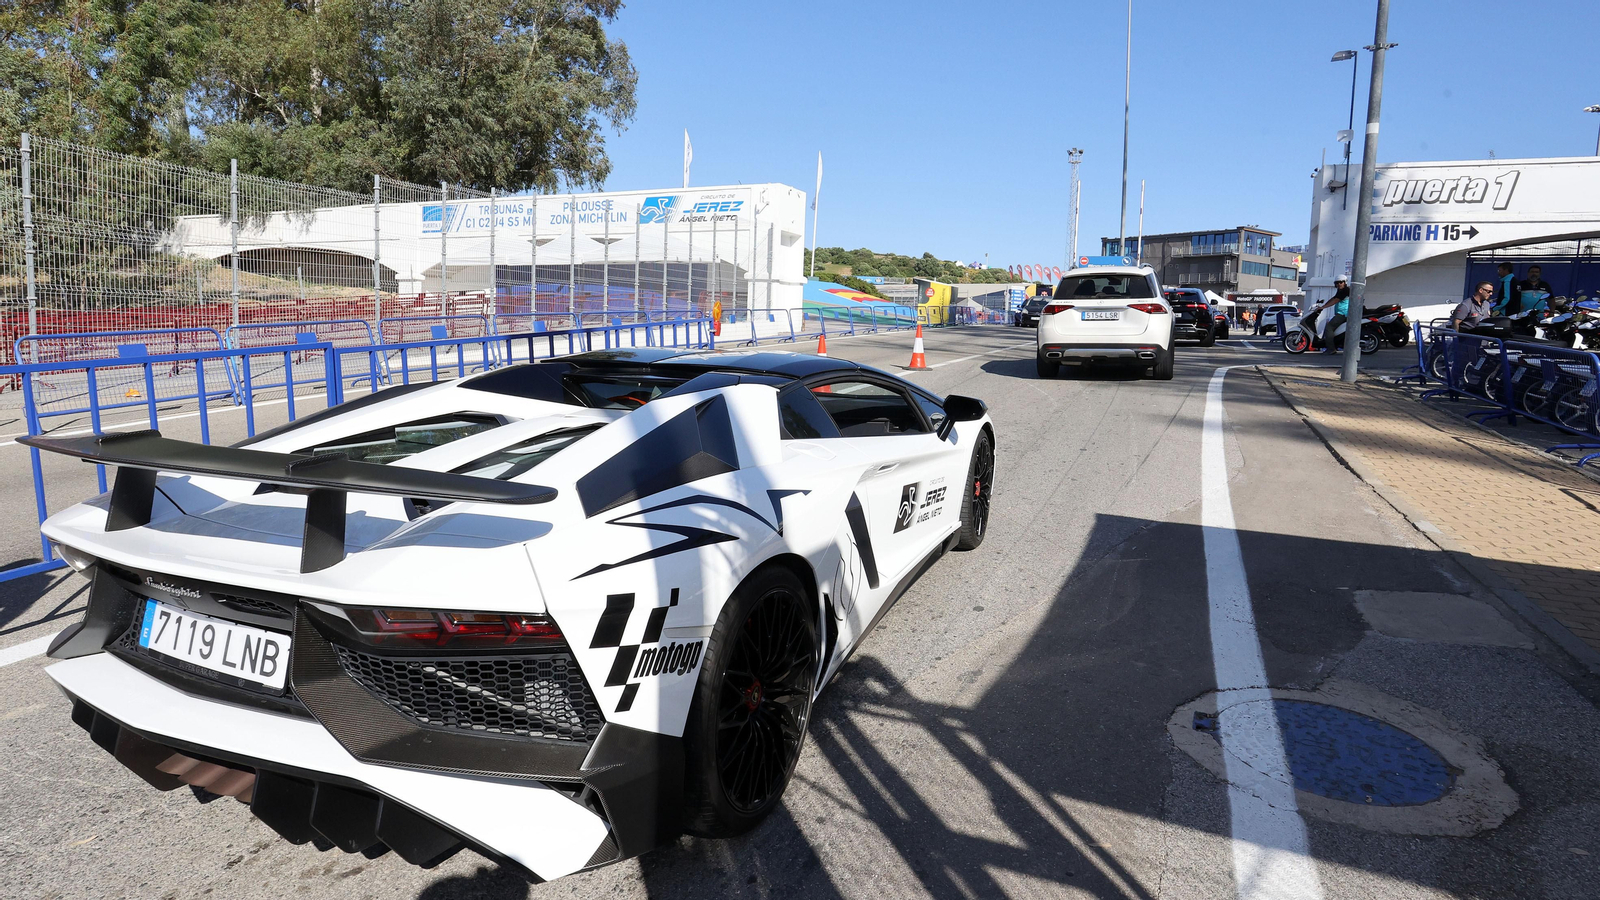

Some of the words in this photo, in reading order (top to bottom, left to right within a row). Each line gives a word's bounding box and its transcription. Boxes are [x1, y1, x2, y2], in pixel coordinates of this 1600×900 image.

[1382, 175, 1489, 208] puerta
[1492, 170, 1520, 211] 1
[683, 200, 744, 214] JEREZ
[507, 216, 520, 227] S5
[522, 216, 536, 227] M
[679, 214, 708, 223] ÁNGEL
[1425, 224, 1440, 241] H
[1442, 224, 1460, 241] 15
[920, 486, 947, 509] JEREZ
[143, 627, 150, 638] E
[154, 610, 216, 660] 7119
[222, 629, 280, 678] LNB
[633, 640, 704, 677] motogp
